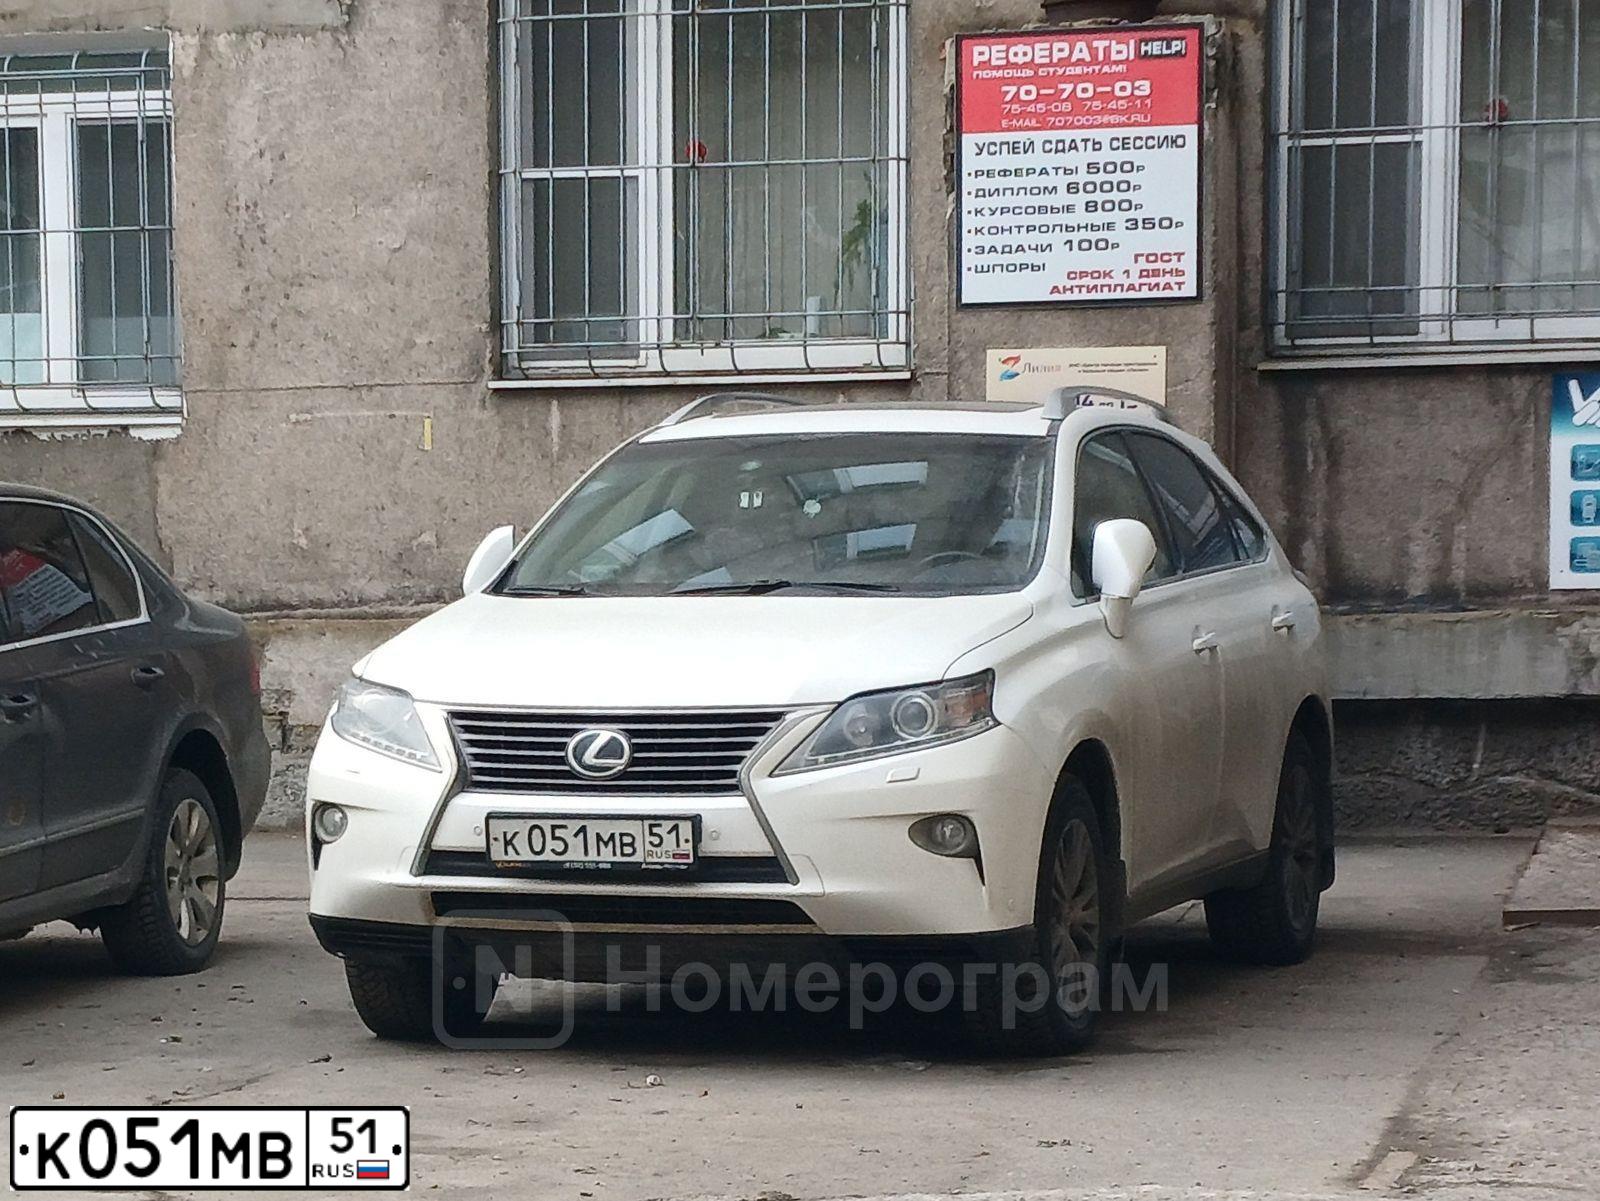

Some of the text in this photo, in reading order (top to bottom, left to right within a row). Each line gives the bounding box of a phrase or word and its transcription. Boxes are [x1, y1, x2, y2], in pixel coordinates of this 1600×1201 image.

[972, 39, 1187, 67] РЕФЕРАТЫ HELP!
[972, 64, 1127, 80] ПОМОЩЬ СТУДЕНТАМ!
[1001, 79, 1151, 102] 70-70-03
[1002, 99, 1151, 114] 75-45-08 75-45-11
[974, 133, 1187, 157] УСПЕЙ СДАТЬ СЕССИЮ
[974, 166, 1079, 180] РЕФЕРАТЫ
[974, 185, 1059, 199] ДИПЛОМ
[974, 203, 1077, 217] КУРСОВЫЕ
[974, 221, 1117, 236] КОНТРОЛЬНЫЕ
[974, 242, 1053, 256] ЗАДАЧИ
[1133, 251, 1186, 264] ГОСТ
[974, 262, 1047, 274] ШПОРЫ
[1066, 266, 1186, 281] СРОК 1 ДЕНЬ
[1049, 281, 1186, 296] АНТИПЛАГИАТ
[502, 822, 681, 858] К051МВ 51
[646, 849, 672, 860] RUS
